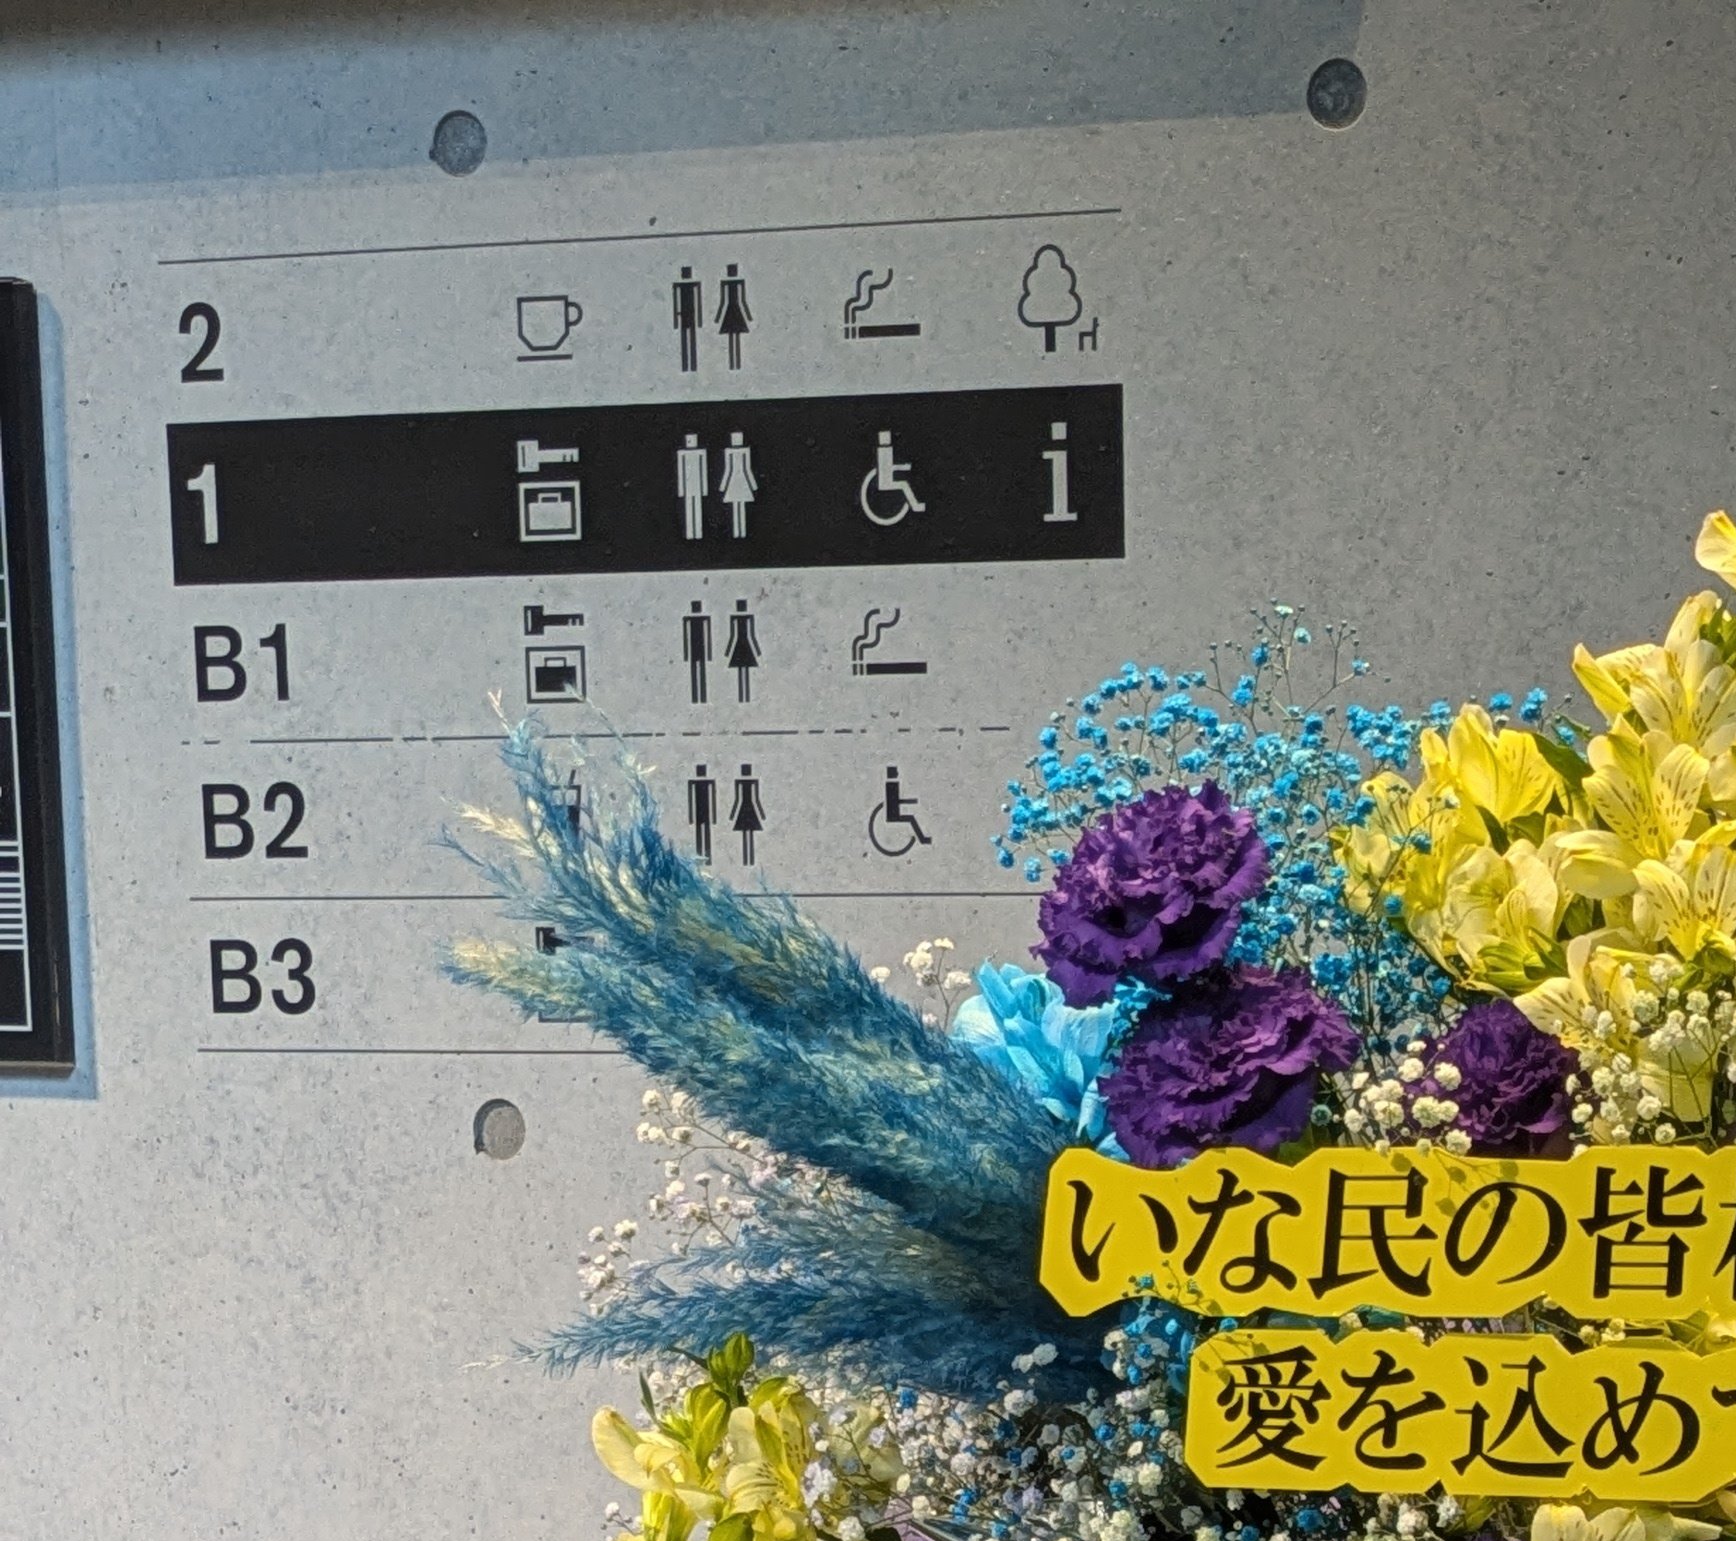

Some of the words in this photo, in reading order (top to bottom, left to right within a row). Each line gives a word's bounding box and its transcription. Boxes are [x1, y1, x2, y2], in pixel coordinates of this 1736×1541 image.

[178, 301, 224, 384] 2
[187, 463, 219, 545] 1
[194, 624, 290, 703] B1
[202, 782, 309, 860] B2
[209, 938, 316, 1015] B3
